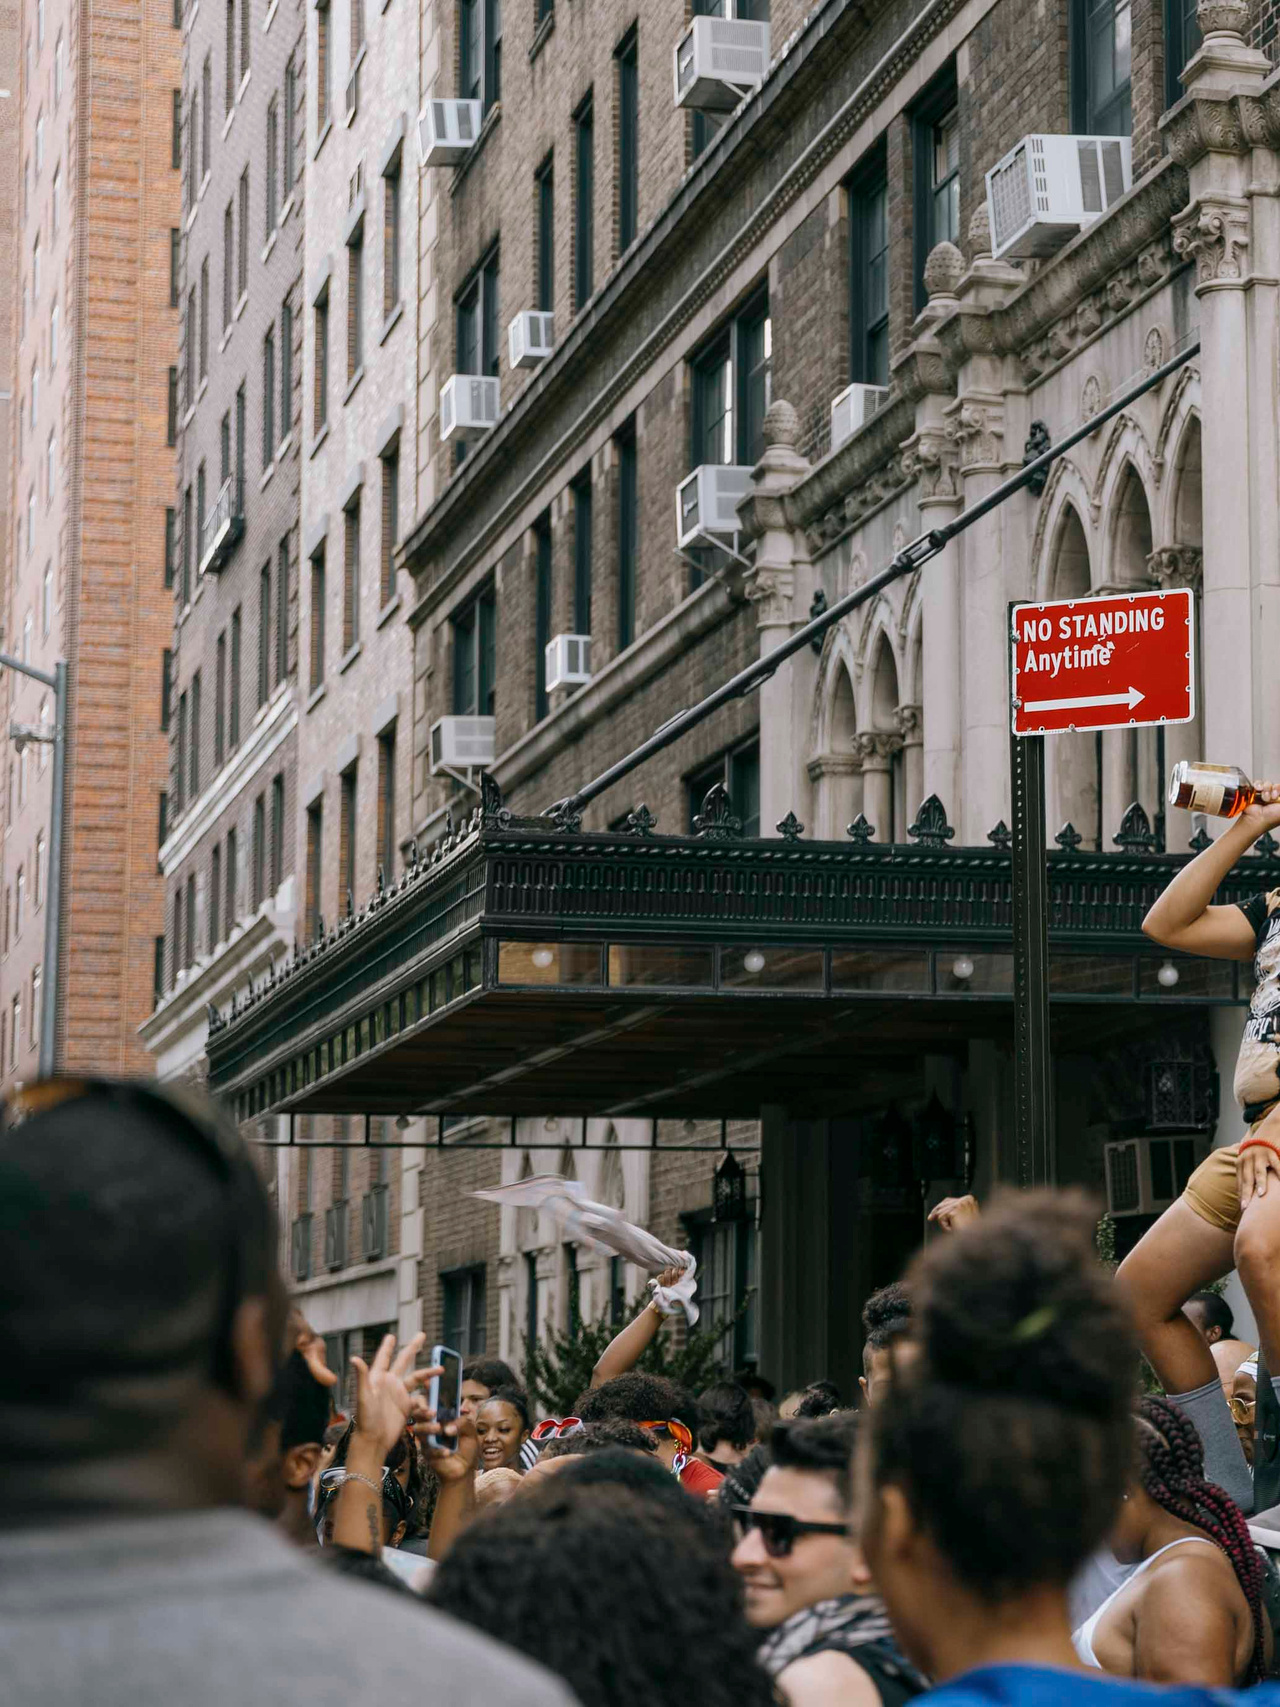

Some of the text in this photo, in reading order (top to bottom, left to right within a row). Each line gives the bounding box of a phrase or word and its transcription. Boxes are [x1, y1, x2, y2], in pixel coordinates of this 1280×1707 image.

[1023, 607, 1165, 643] NO STANDING
[1024, 644, 1112, 678] Anytime
